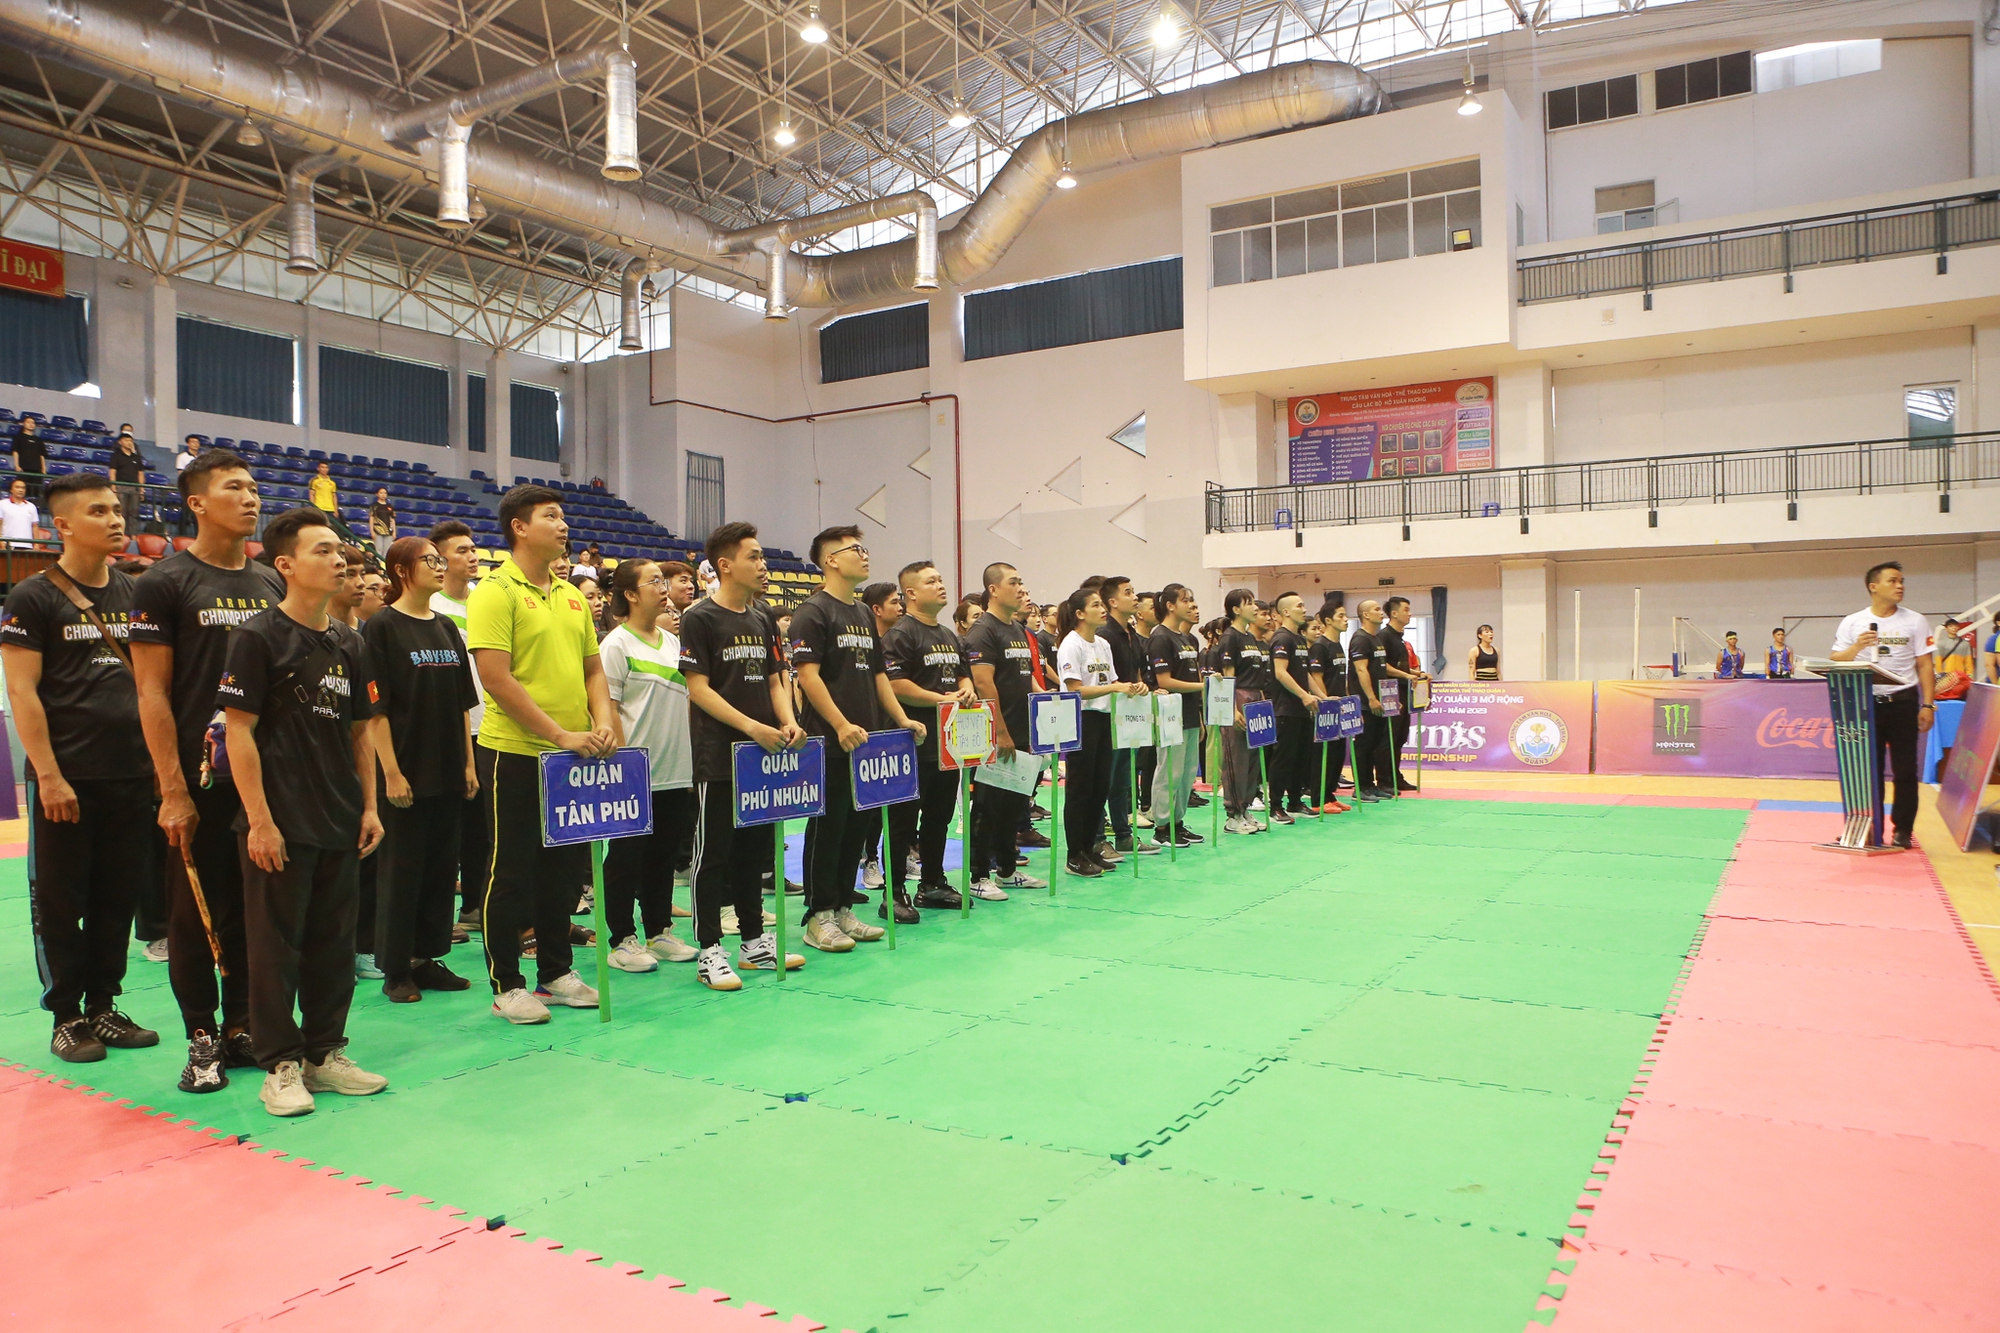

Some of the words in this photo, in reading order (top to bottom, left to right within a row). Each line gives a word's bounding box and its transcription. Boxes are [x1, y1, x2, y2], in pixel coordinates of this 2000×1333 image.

[13, 255, 47, 284] ĐẠI
[216, 597, 268, 609] ARNIS
[130, 621, 160, 632] CRIMA
[1431, 694, 1443, 704] ẬY
[1444, 694, 1470, 704] QUẬN
[1471, 695, 1478, 703] 3
[1496, 694, 1524, 705] RỘNG
[1249, 713, 1267, 734] QUẬN
[1267, 716, 1273, 729] 3
[1318, 710, 1334, 730] QUẬN
[1334, 713, 1339, 726] 4
[1404, 722, 1486, 751] rnis
[761, 749, 799, 777] QUẬN
[859, 751, 899, 784] QUẬN
[902, 753, 911, 776] 8
[1401, 753, 1477, 762] AMPIONSHIP
[568, 760, 623, 790] QUẬN
[555, 799, 596, 827] TÂN
[600, 794, 640, 823] PHÚ
[741, 785, 769, 812] PHÚ
[773, 781, 819, 808] NHUẬN
